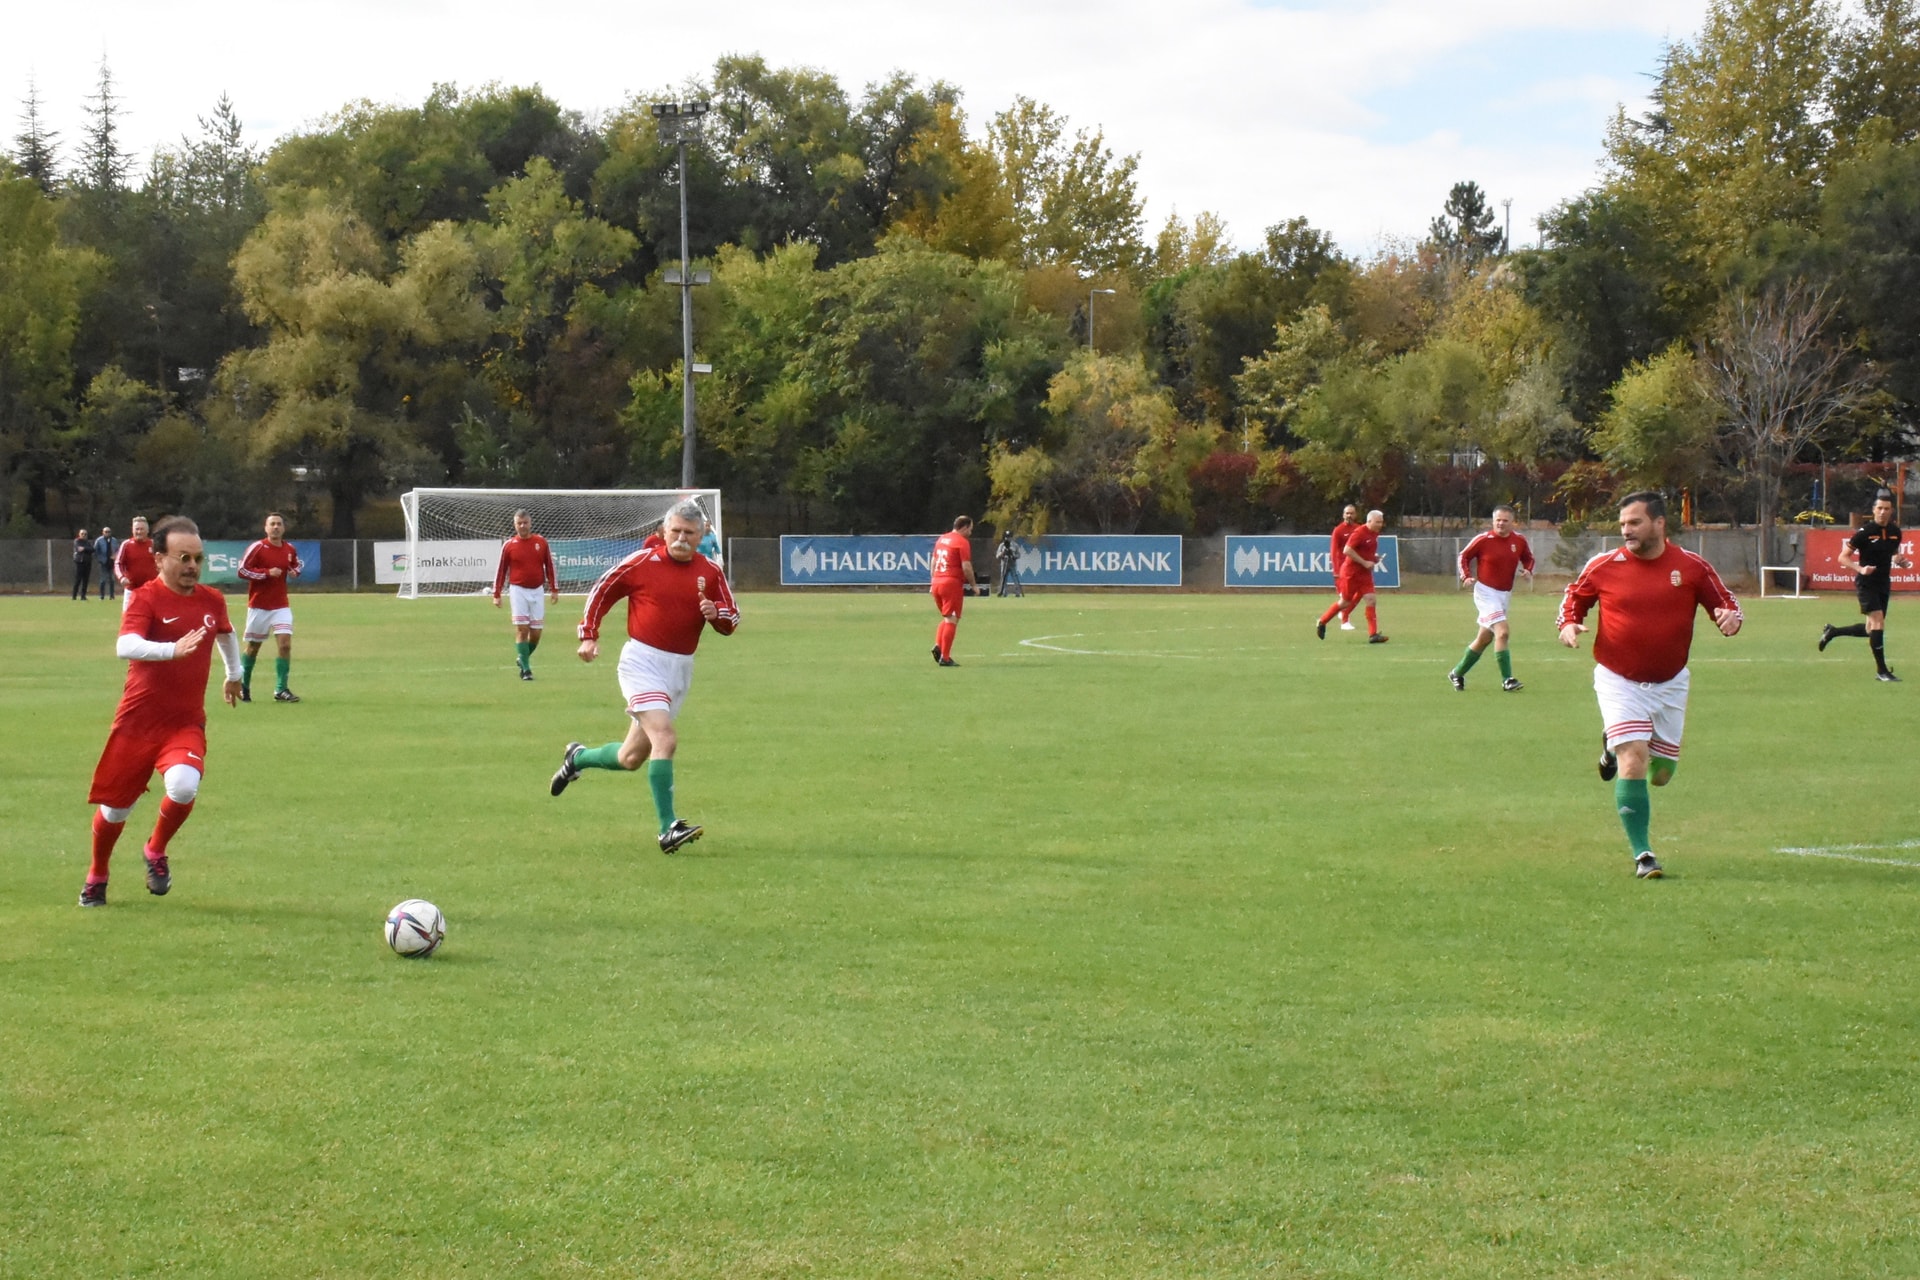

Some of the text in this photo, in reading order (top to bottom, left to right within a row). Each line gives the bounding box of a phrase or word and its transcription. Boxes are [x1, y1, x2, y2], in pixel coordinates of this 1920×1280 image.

[559, 555, 623, 566] EmlakKatıl
[820, 552, 930, 571] HALKBAN
[1045, 552, 1172, 571] HALKBANK
[1263, 552, 1389, 573] HALKBK
[1812, 573, 1832, 582] Kredi
[1903, 573, 1915, 582] tek
